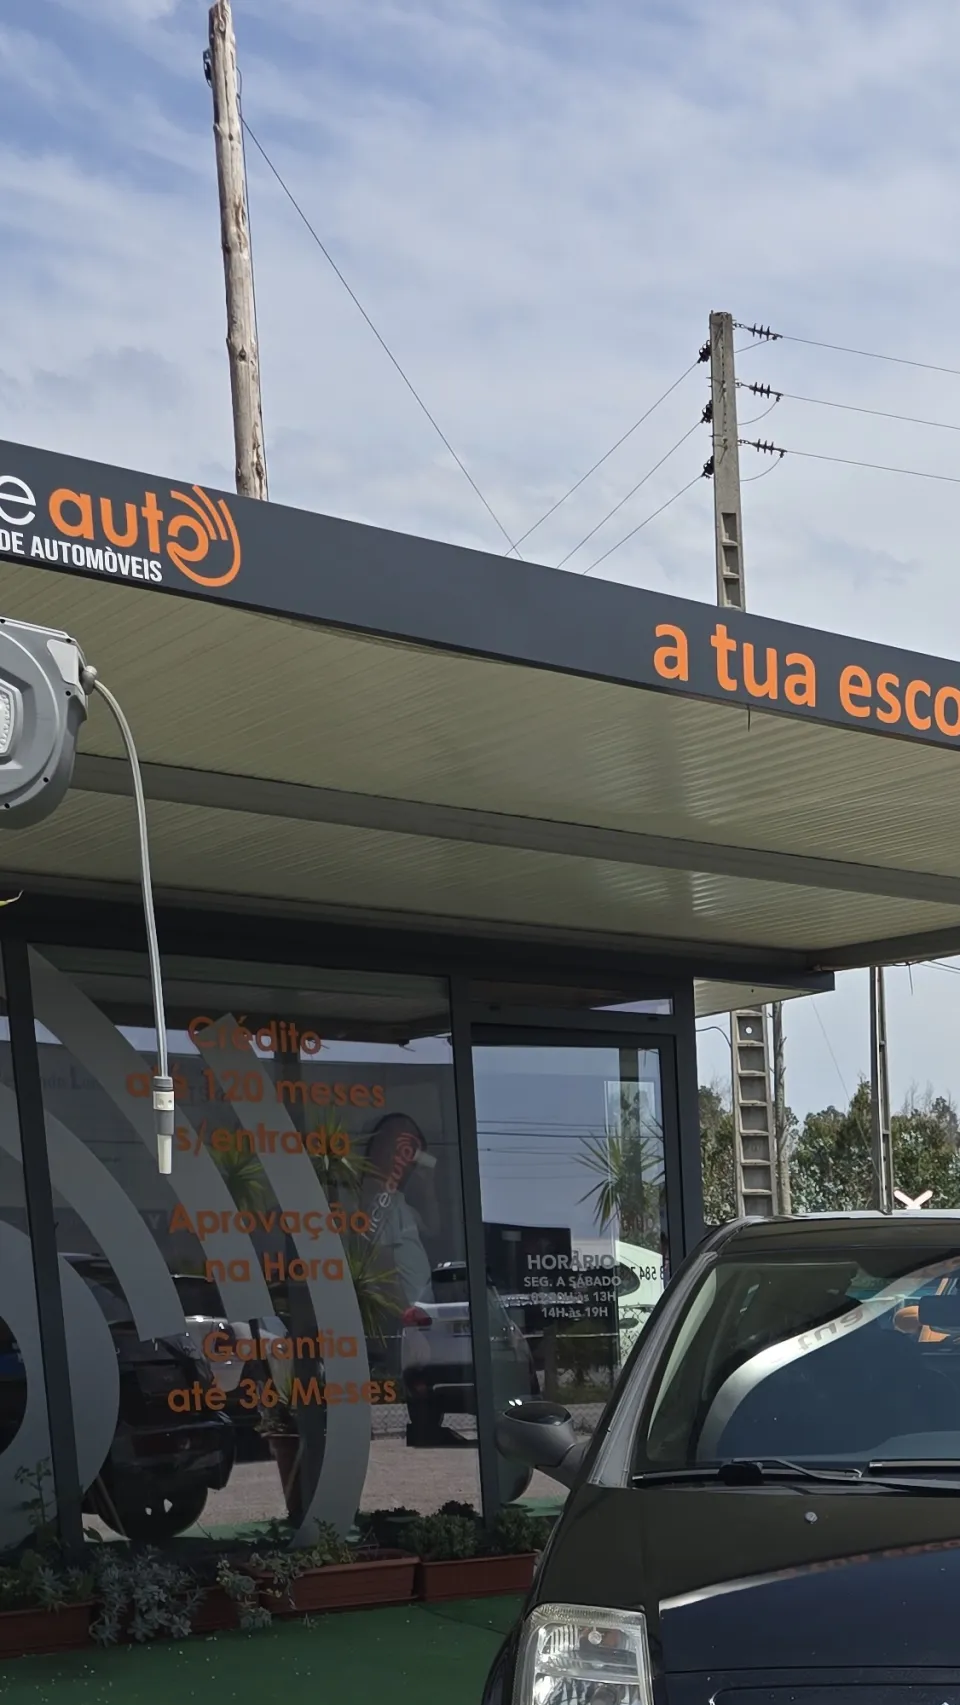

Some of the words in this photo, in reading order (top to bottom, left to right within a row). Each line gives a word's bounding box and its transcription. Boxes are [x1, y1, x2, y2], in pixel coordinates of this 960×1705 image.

[49, 486, 225, 570] auto
[652, 623, 689, 682] a
[710, 624, 816, 708] tua
[188, 1015, 322, 1055] Crédito
[203, 1068, 264, 1102] 120
[276, 1079, 386, 1108] meses
[176, 1120, 350, 1157] s/entrada
[169, 1201, 371, 1242] Aprovação
[205, 1258, 251, 1283] na
[263, 1251, 344, 1282] Hora
[527, 1251, 616, 1271] HORÁRIO
[524, 1276, 553, 1288] SEG.
[556, 1276, 566, 1287] A
[569, 1274, 622, 1288] SÁBADO
[593, 1291, 616, 1302] 13H
[542, 1306, 565, 1318] 14H
[585, 1306, 608, 1317] 19H
[203, 1327, 359, 1363] Garantia
[167, 1375, 227, 1413] até
[239, 1378, 274, 1409] 36
[290, 1376, 397, 1406] Meses
